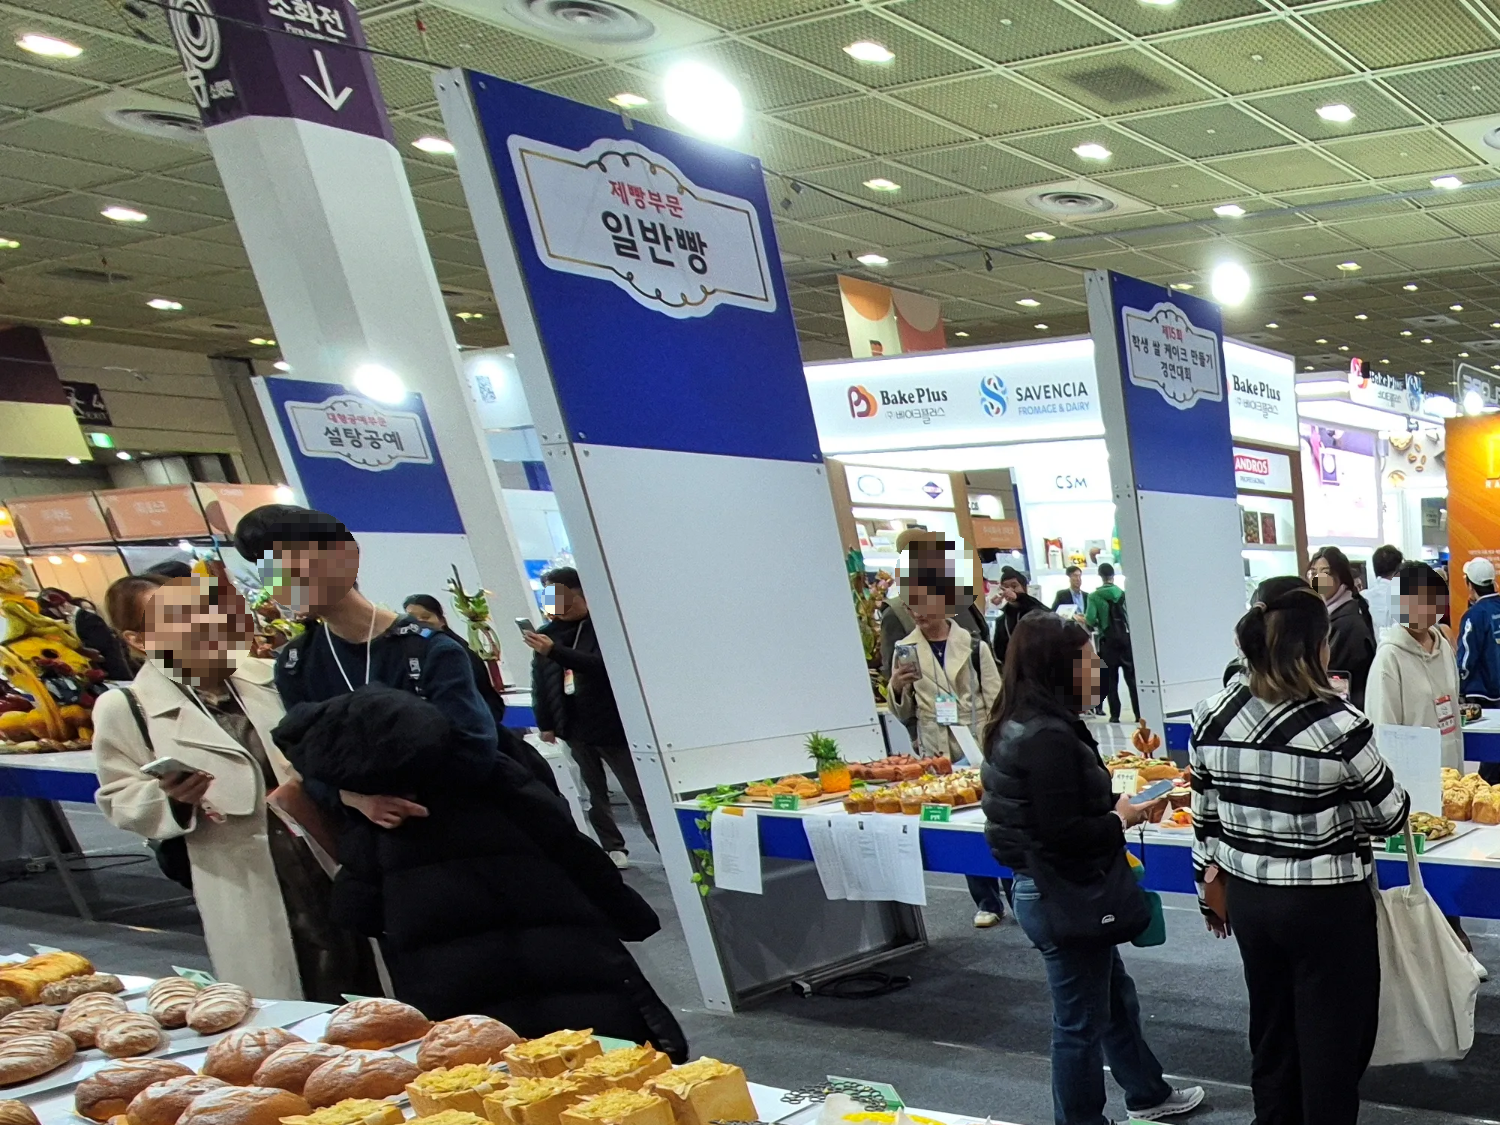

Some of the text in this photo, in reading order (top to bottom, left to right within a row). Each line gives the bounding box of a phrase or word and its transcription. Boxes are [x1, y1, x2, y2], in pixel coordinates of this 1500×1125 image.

[609, 180, 683, 219] 제빵부문
[601, 211, 708, 275] 일반빵
[1162, 325, 1183, 343] 제15회
[1132, 335, 1214, 369] 학생 쌀 케이크 만들기
[1161, 361, 1193, 383] 경연대회
[1015, 381, 1088, 402] SAVENCIA
[1018, 401, 1090, 416] FROMAGE & DAIRY
[324, 426, 404, 451] 설탕공예
[1235, 457, 1269, 475] ANDROS
[1055, 475, 1088, 489] CSM
